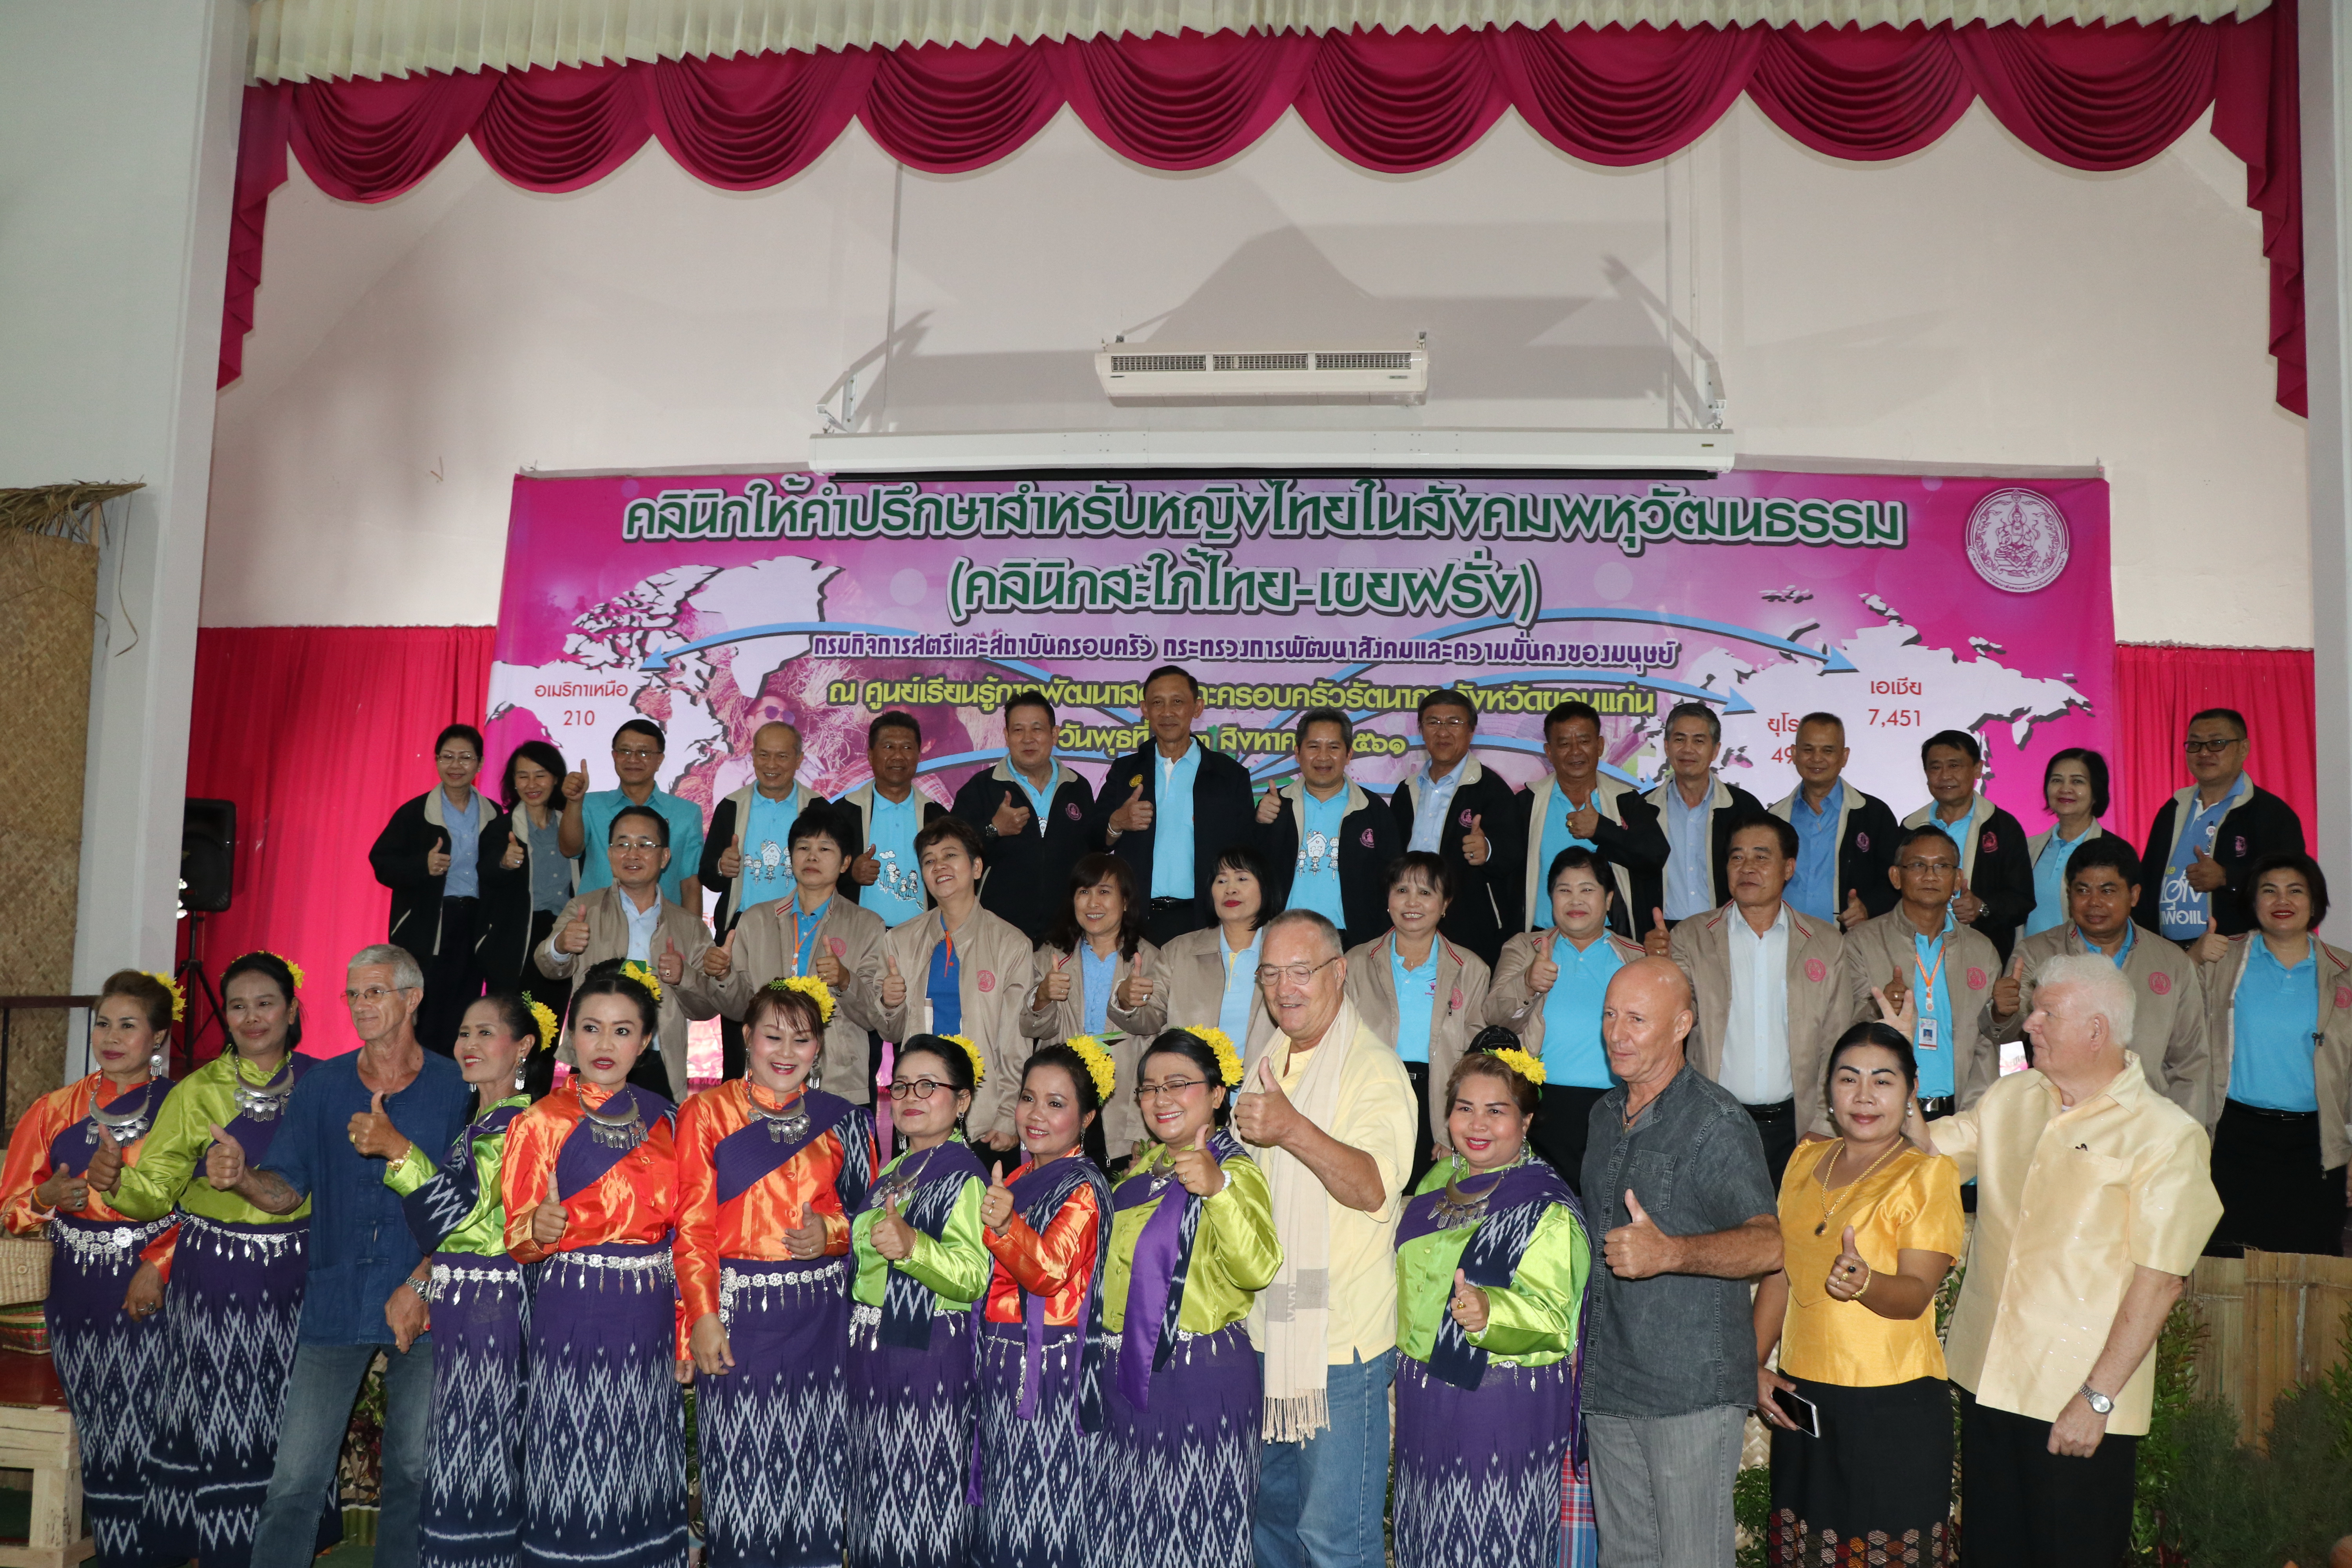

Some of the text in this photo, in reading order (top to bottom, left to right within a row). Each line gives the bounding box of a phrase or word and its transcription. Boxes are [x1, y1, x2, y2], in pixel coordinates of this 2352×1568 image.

[626, 477, 1898, 549] คลินิกให้คำปรึกษาสำหรับหญิงไทยในสังคมพหุวัฒนธรรม
[814, 631, 1676, 671] กรมกิจการสตรีและสถาบันครอบครัว กระทรวงการพัฒนาสังคมและความมั่นคงของมนุษย์
[535, 680, 628, 697] อเมริกาเหนือ
[830, 683, 856, 702] ณ
[1871, 677, 1922, 695] เอเชีย
[564, 710, 595, 726] 210
[1868, 709, 1921, 727] 7,451
